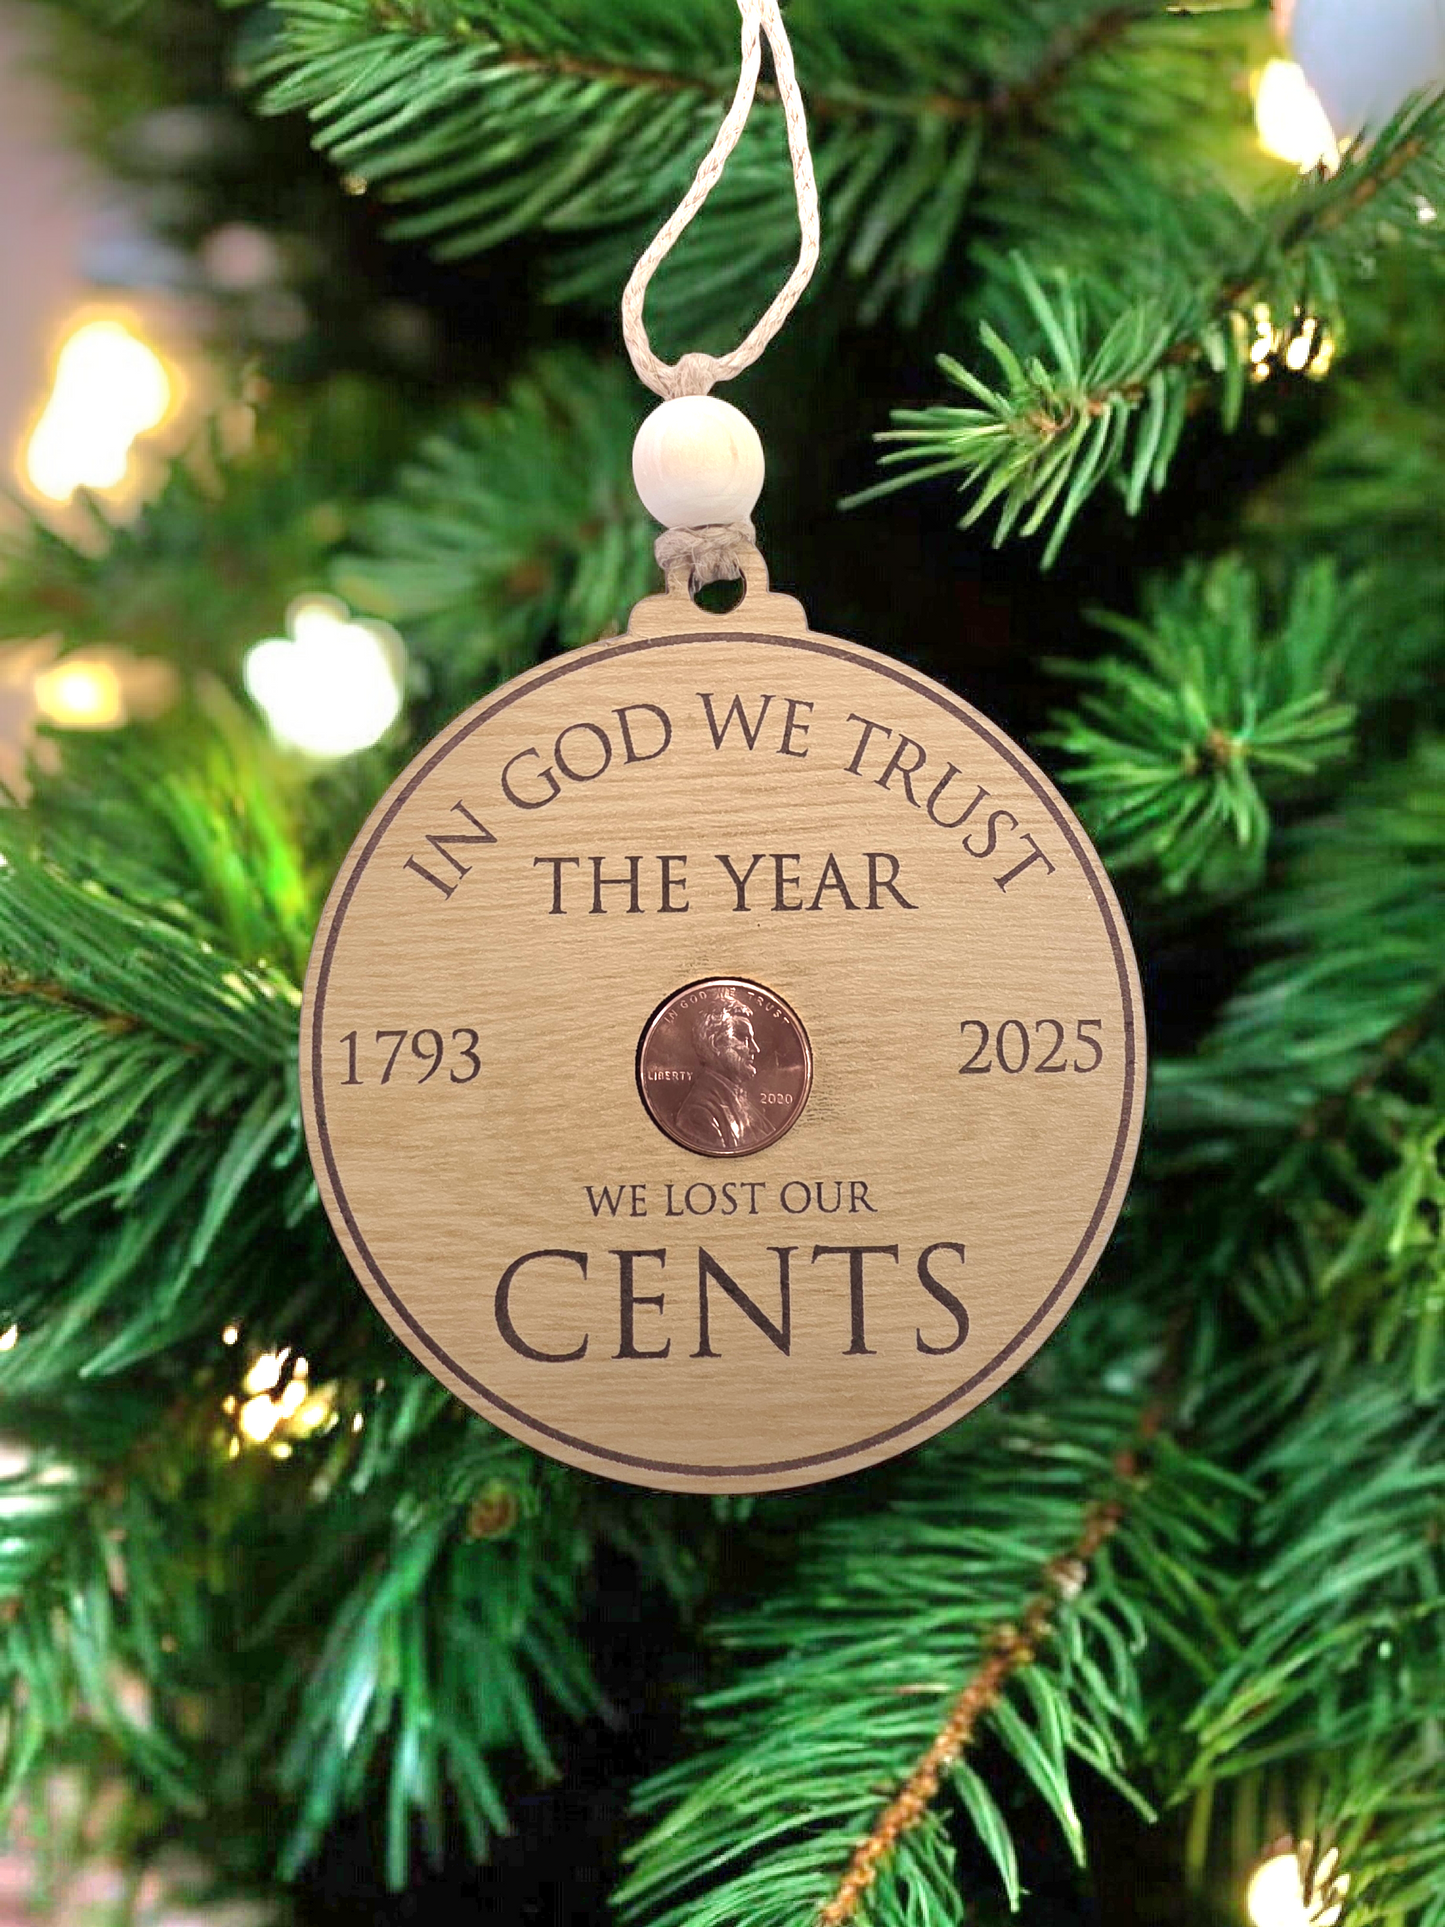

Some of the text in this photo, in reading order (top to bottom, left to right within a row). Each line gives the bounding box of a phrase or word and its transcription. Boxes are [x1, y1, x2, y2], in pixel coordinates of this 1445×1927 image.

[403, 693, 1055, 900] IN GOD WE TRUST
[534, 853, 919, 914] THE YEAR
[680, 991, 707, 1009] GOD
[748, 992, 790, 1024] TRUST
[340, 1028, 481, 1084] 1793
[959, 1019, 1102, 1074] 2025
[648, 1071, 693, 1081] LIBERTY
[760, 1093, 793, 1104] 2020
[583, 1181, 878, 1217] WE LOST OUR
[494, 1242, 969, 1363] CENTS
